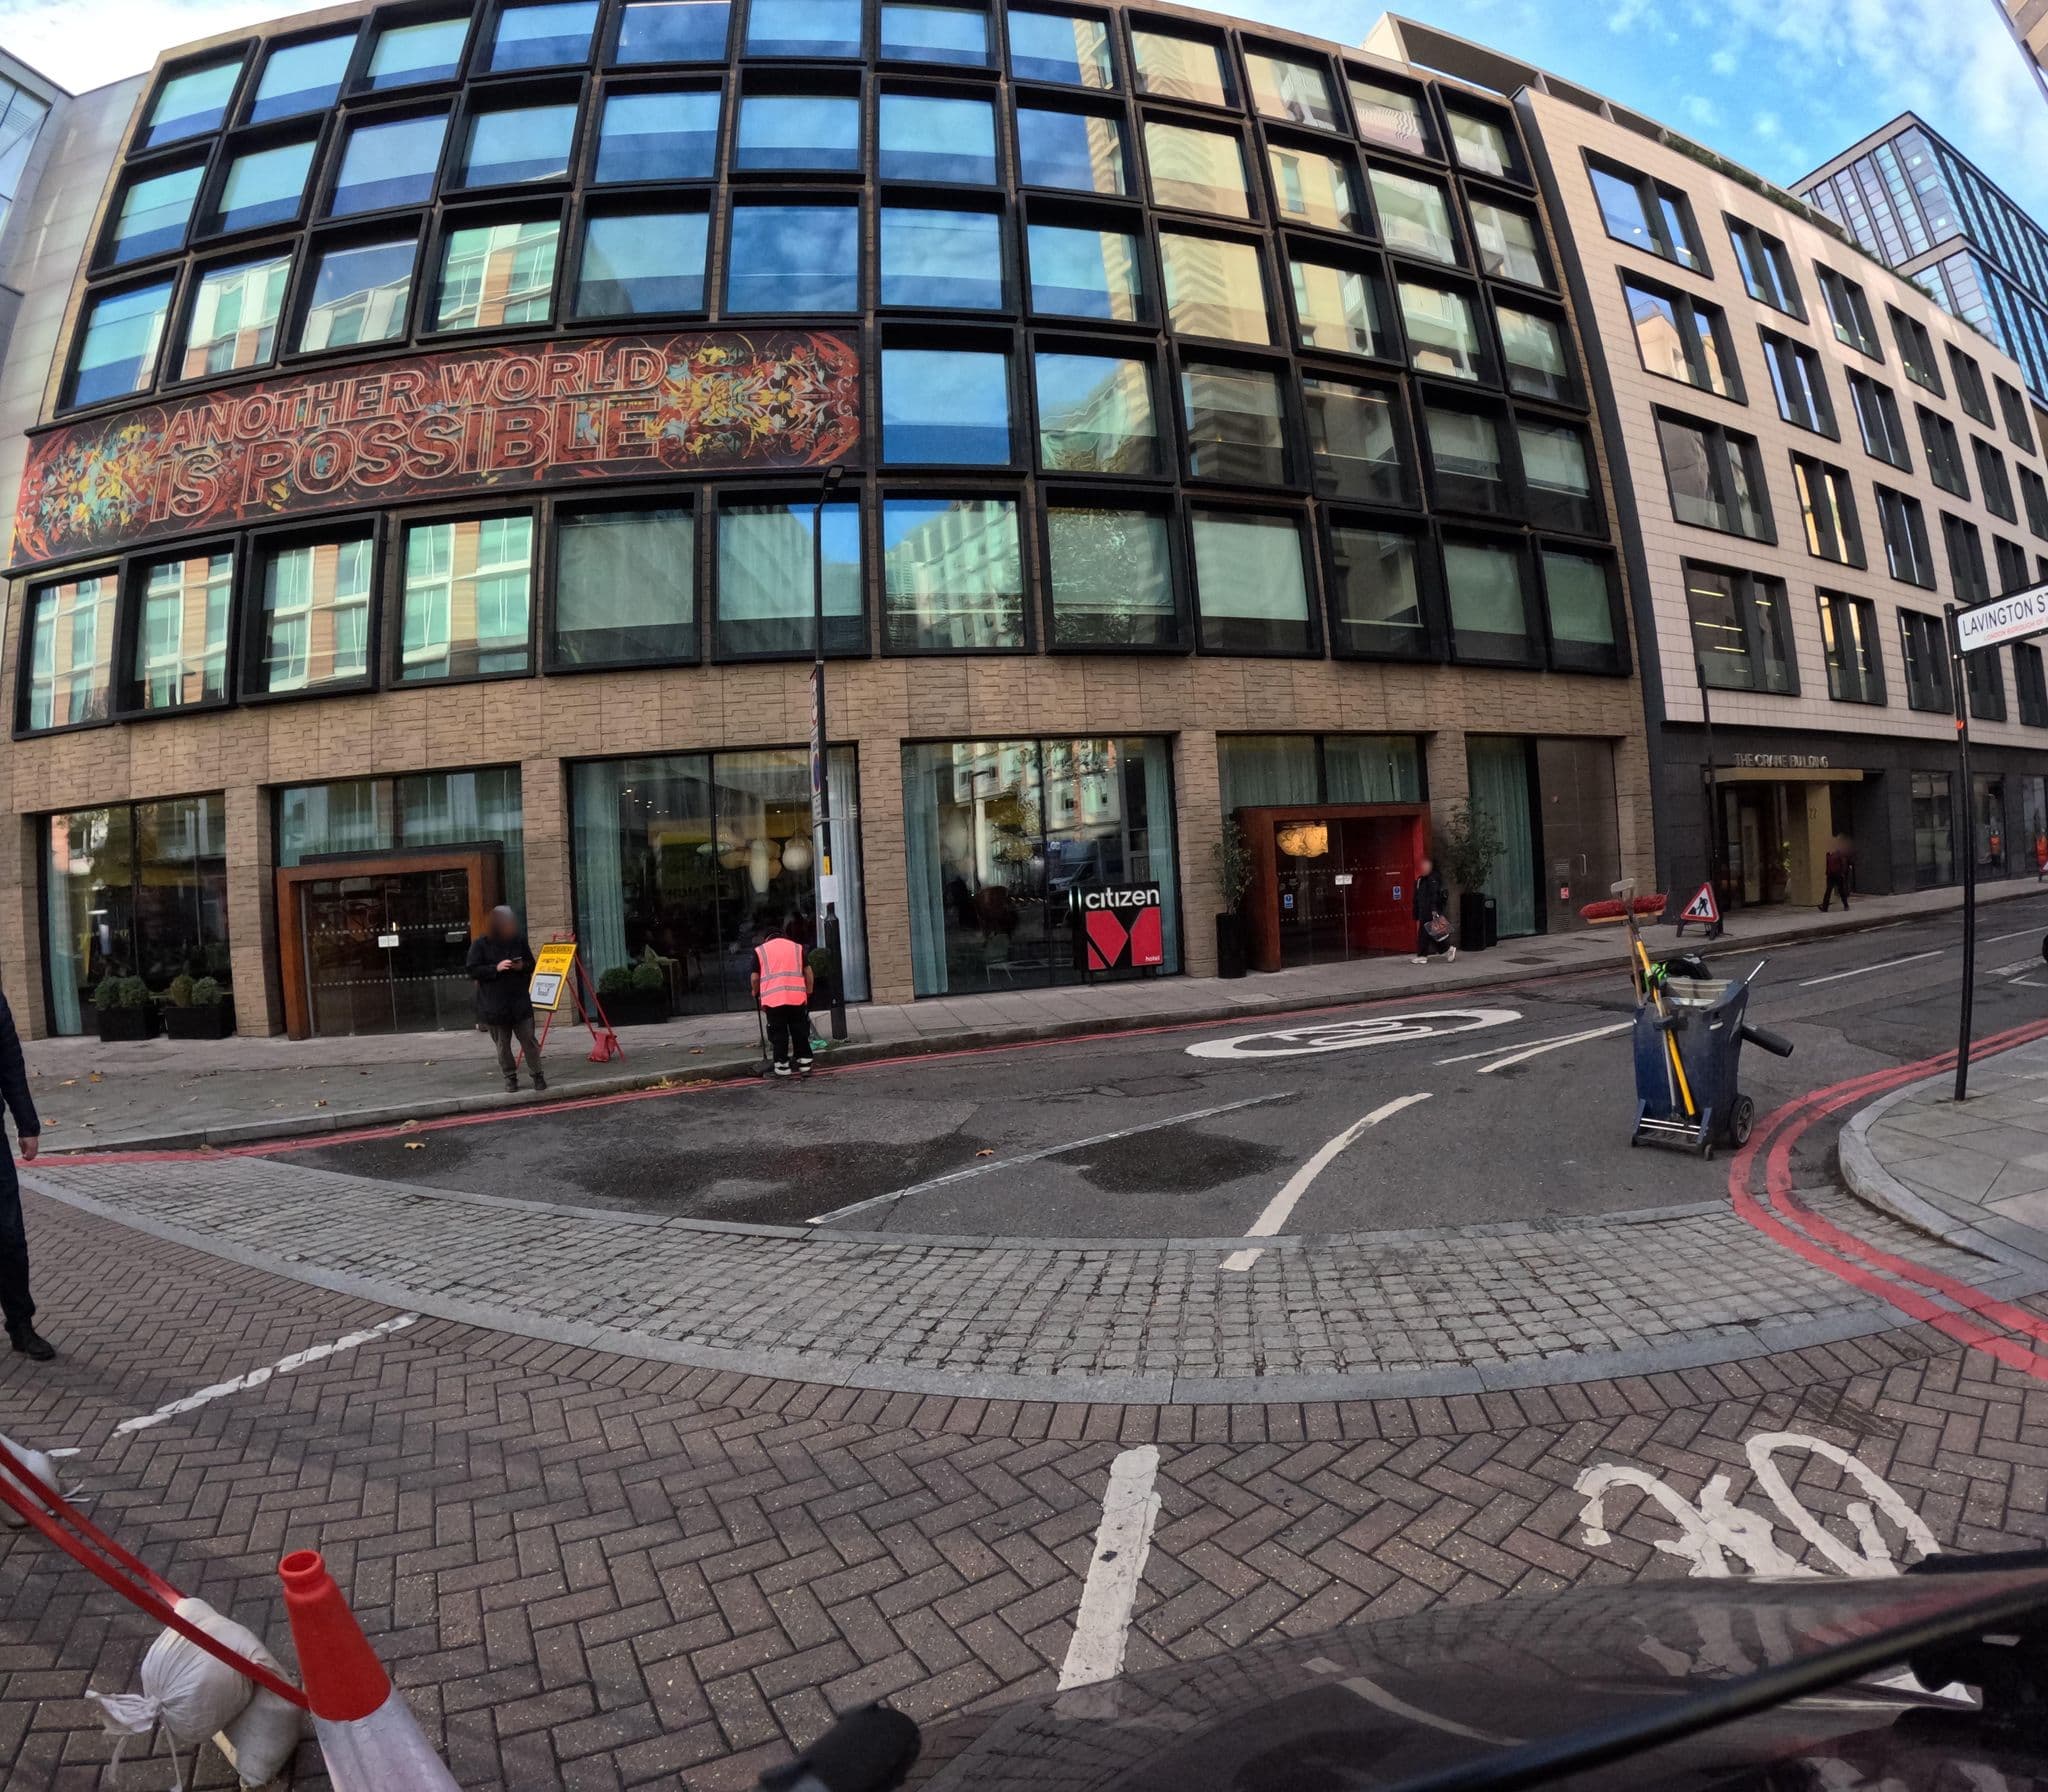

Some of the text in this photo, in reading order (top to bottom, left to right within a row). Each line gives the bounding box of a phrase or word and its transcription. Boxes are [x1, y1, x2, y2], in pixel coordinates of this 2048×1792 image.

[153, 347, 667, 459] ANOTHER WORLD
[150, 396, 660, 522] IS POSSIBLE
[1962, 598, 2033, 637] LAVINGTON
[1734, 752, 1754, 768] THE
[1789, 754, 1829, 769] BUILDING
[1085, 887, 1160, 909] citizen
